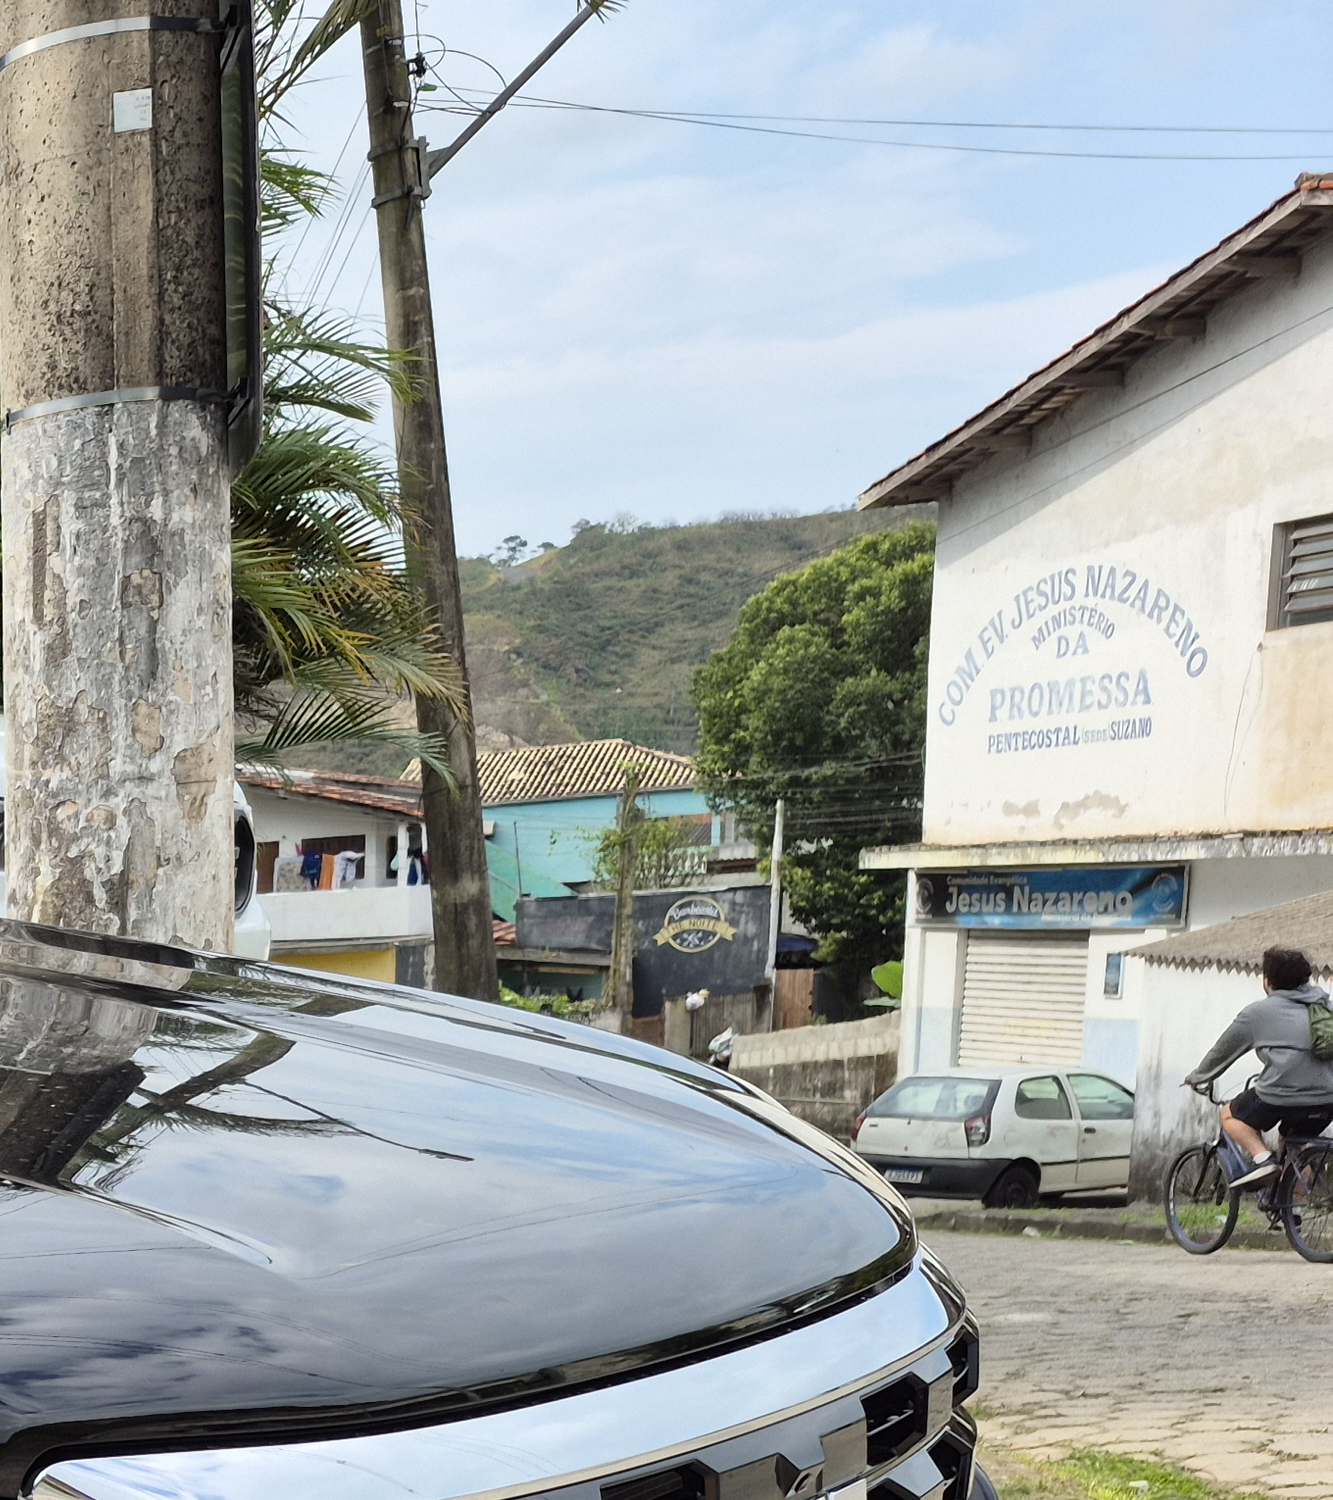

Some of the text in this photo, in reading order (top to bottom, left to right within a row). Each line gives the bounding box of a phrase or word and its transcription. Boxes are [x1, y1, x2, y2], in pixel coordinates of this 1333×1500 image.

[938, 647, 984, 726] COM.
[1011, 567, 1077, 631] JESUS
[1084, 564, 1209, 679] NAZARENO
[1030, 602, 1116, 651] MINISTÉRIO
[1056, 631, 1090, 659] DA
[988, 668, 1153, 723] PROMESSA
[987, 723, 1081, 754] PENTECOSTAL
[1110, 716, 1153, 741] SUZANO
[945, 885, 1133, 913] Jesus Nazareno
